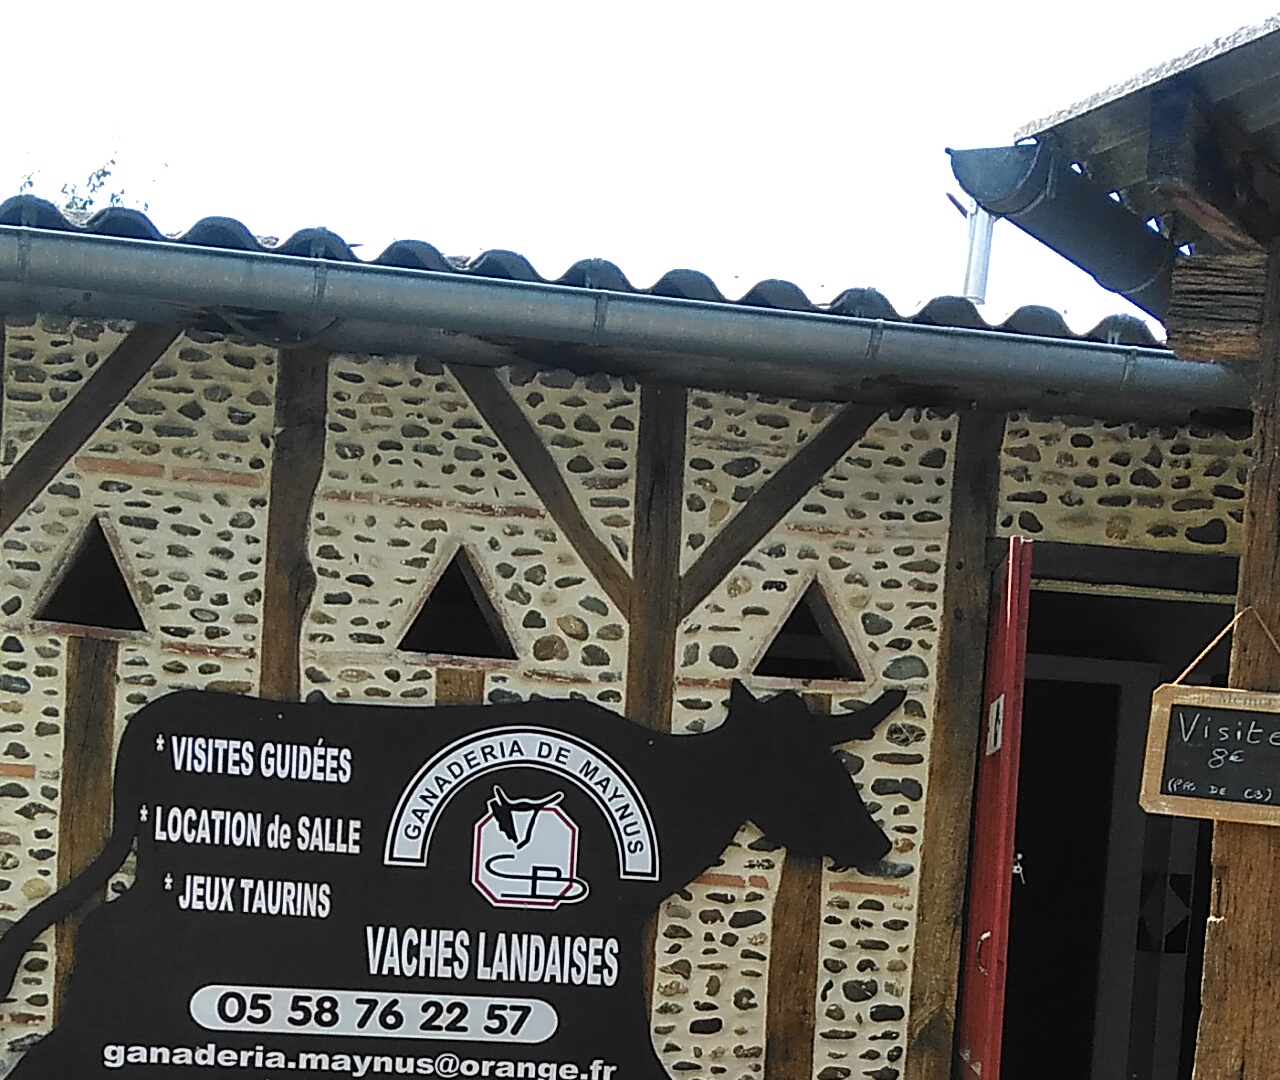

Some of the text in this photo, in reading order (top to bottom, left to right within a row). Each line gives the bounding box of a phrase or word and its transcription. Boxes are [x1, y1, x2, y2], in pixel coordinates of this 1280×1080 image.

[171, 735, 352, 783] VISITES GUIDÉES
[1207, 748, 1245, 769] 8€
[404, 740, 644, 855] GANADERIA DE MAYNUS
[1208, 785, 1228, 796] DE
[154, 806, 362, 854] LOCATION de SALLE
[178, 874, 331, 918] JEUX TAURINS
[366, 926, 619, 986] VACHES LANDAISES
[217, 991, 532, 1036] 05 58 76 22 57
